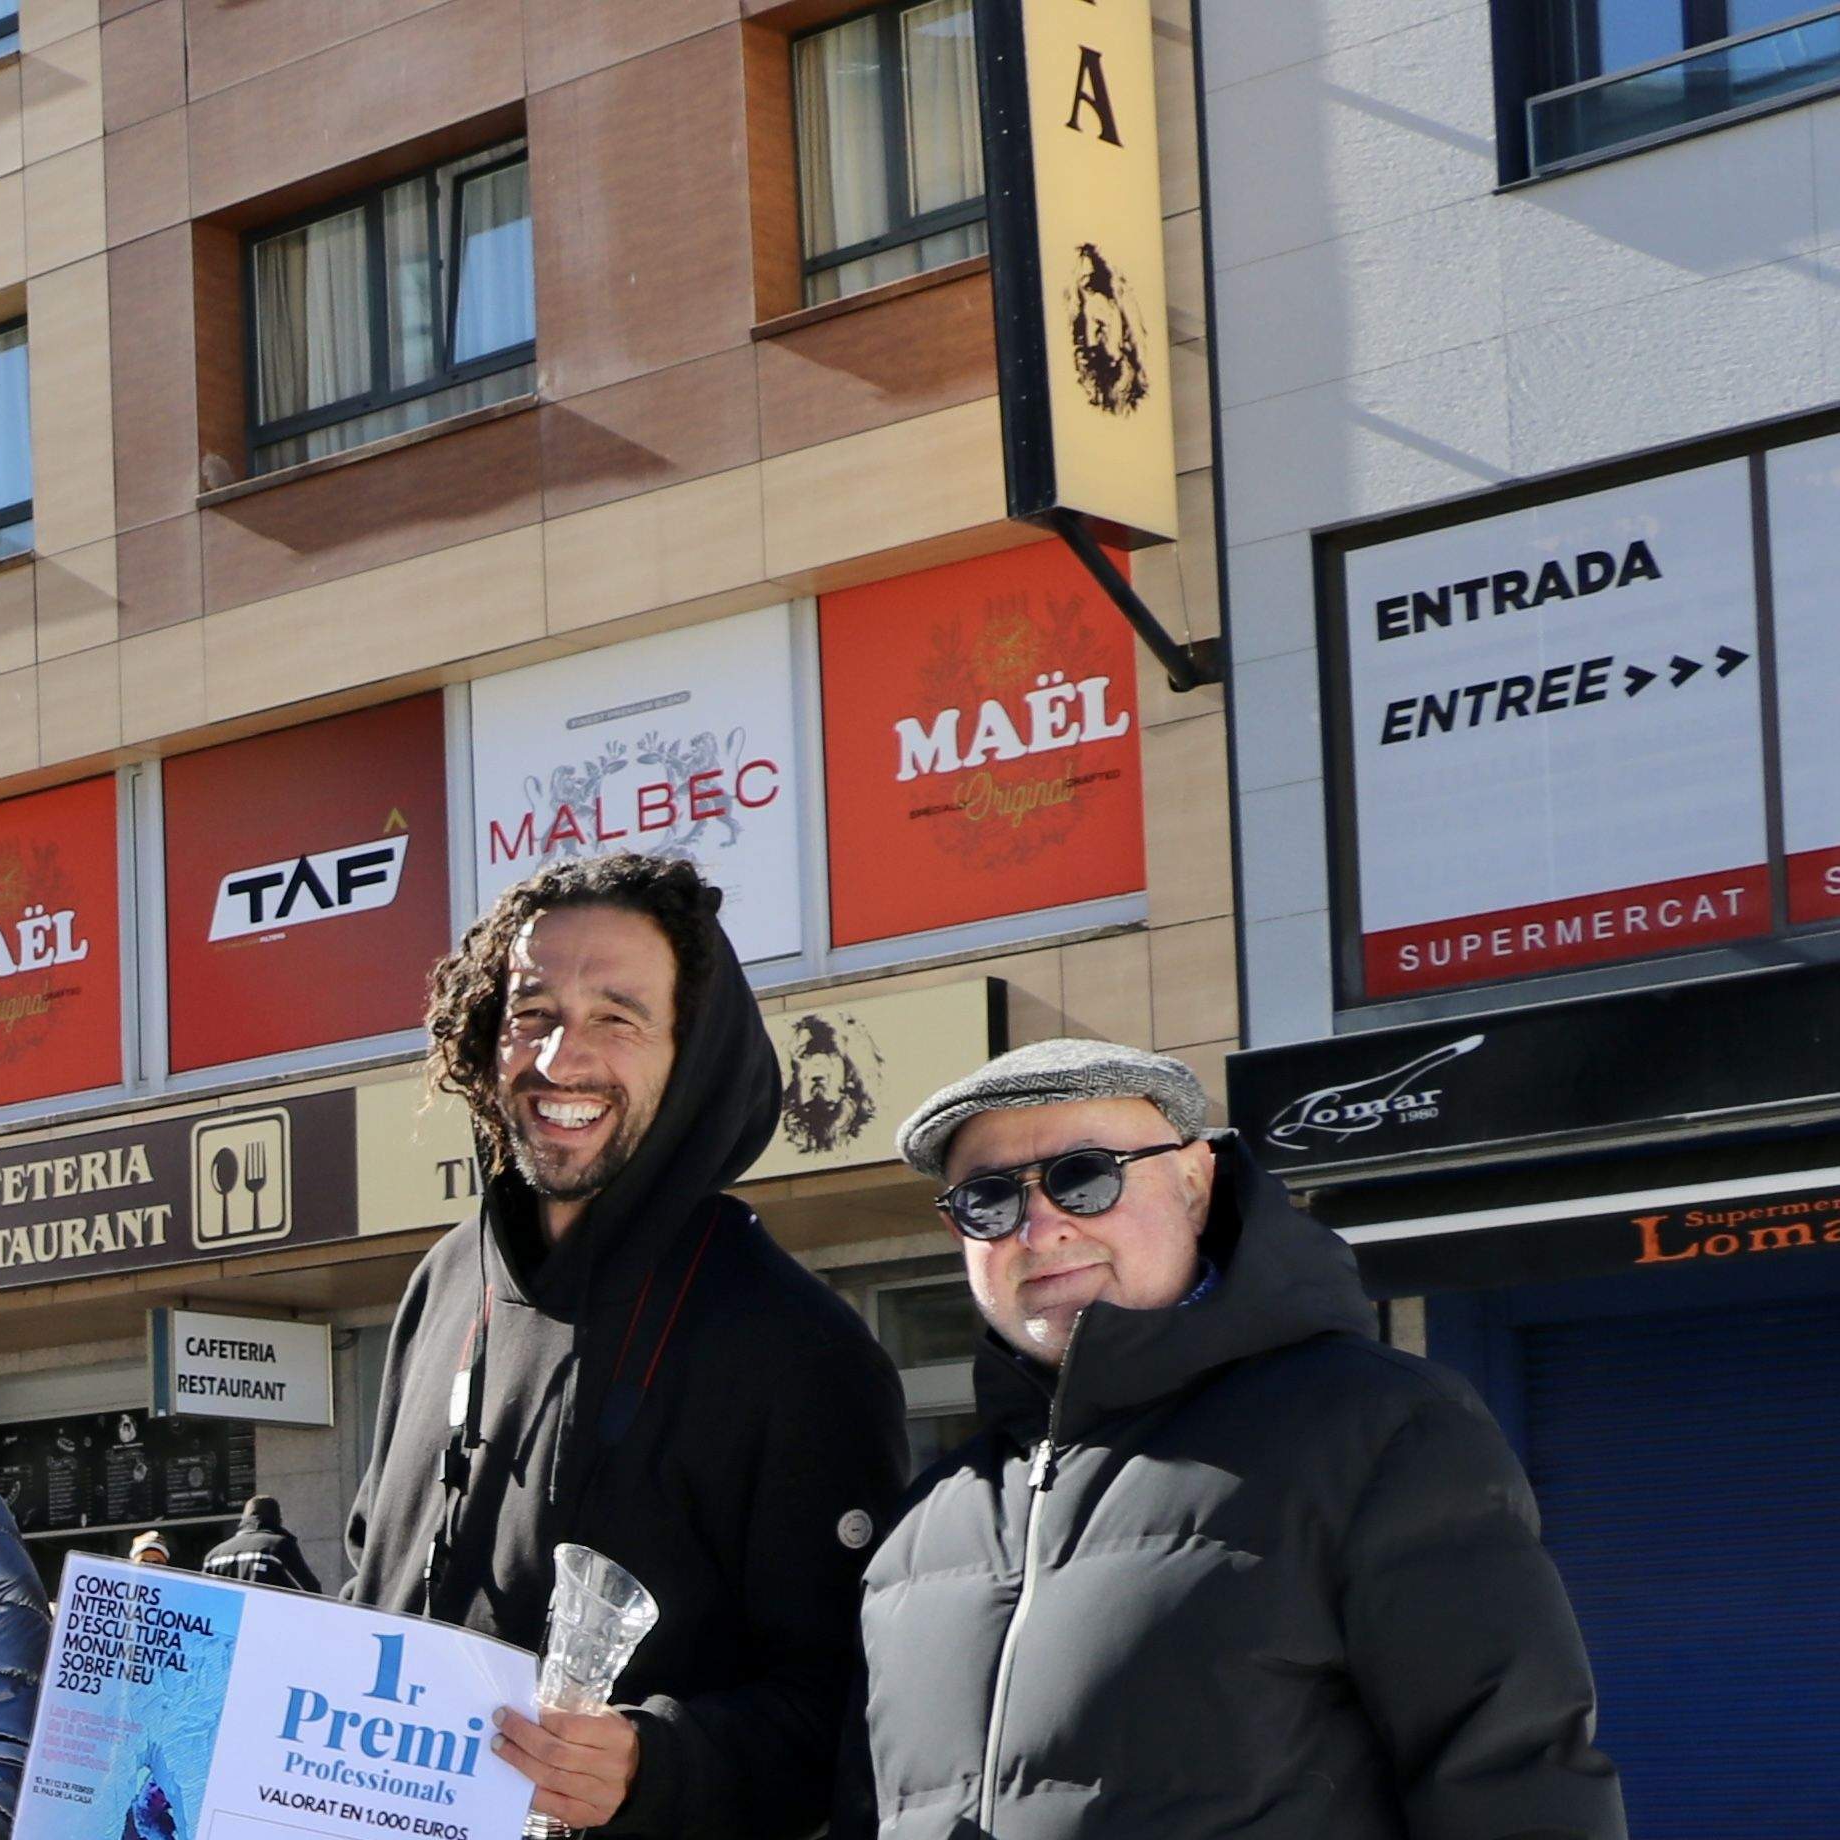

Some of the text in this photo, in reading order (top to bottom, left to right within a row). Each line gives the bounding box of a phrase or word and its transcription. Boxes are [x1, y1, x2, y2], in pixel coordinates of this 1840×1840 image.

[1376, 539, 1663, 641] ENTRADA
[1381, 656, 1614, 745] ENTREE
[895, 670, 1131, 782] MAËL
[489, 759, 780, 864] MALBEC
[954, 757, 1076, 828] Original
[228, 853, 394, 923] TAF
[1398, 888, 1746, 972] SUPERMERCAT
[1273, 1086, 1443, 1137] Lomar
[1398, 1107, 1440, 1124] 1980
[186, 1337, 277, 1363] CAFETERIA
[177, 1374, 287, 1401] RESTAURANT
[75, 1575, 161, 1605] CONCURS
[67, 1613, 183, 1650] D'ESCULTURA
[72, 1594, 214, 1636] INTERNACIONAL
[60, 1652, 154, 1685] SOBRE NEU
[63, 1632, 188, 1672] MONUMENTAL
[57, 1671, 102, 1694] 2023
[276, 1686, 484, 1777] Premi
[284, 1751, 457, 1806] Professionals
[259, 1785, 338, 1816] VALORAT
[340, 1803, 363, 1820] EN
[366, 1808, 411, 1831] 1.000
